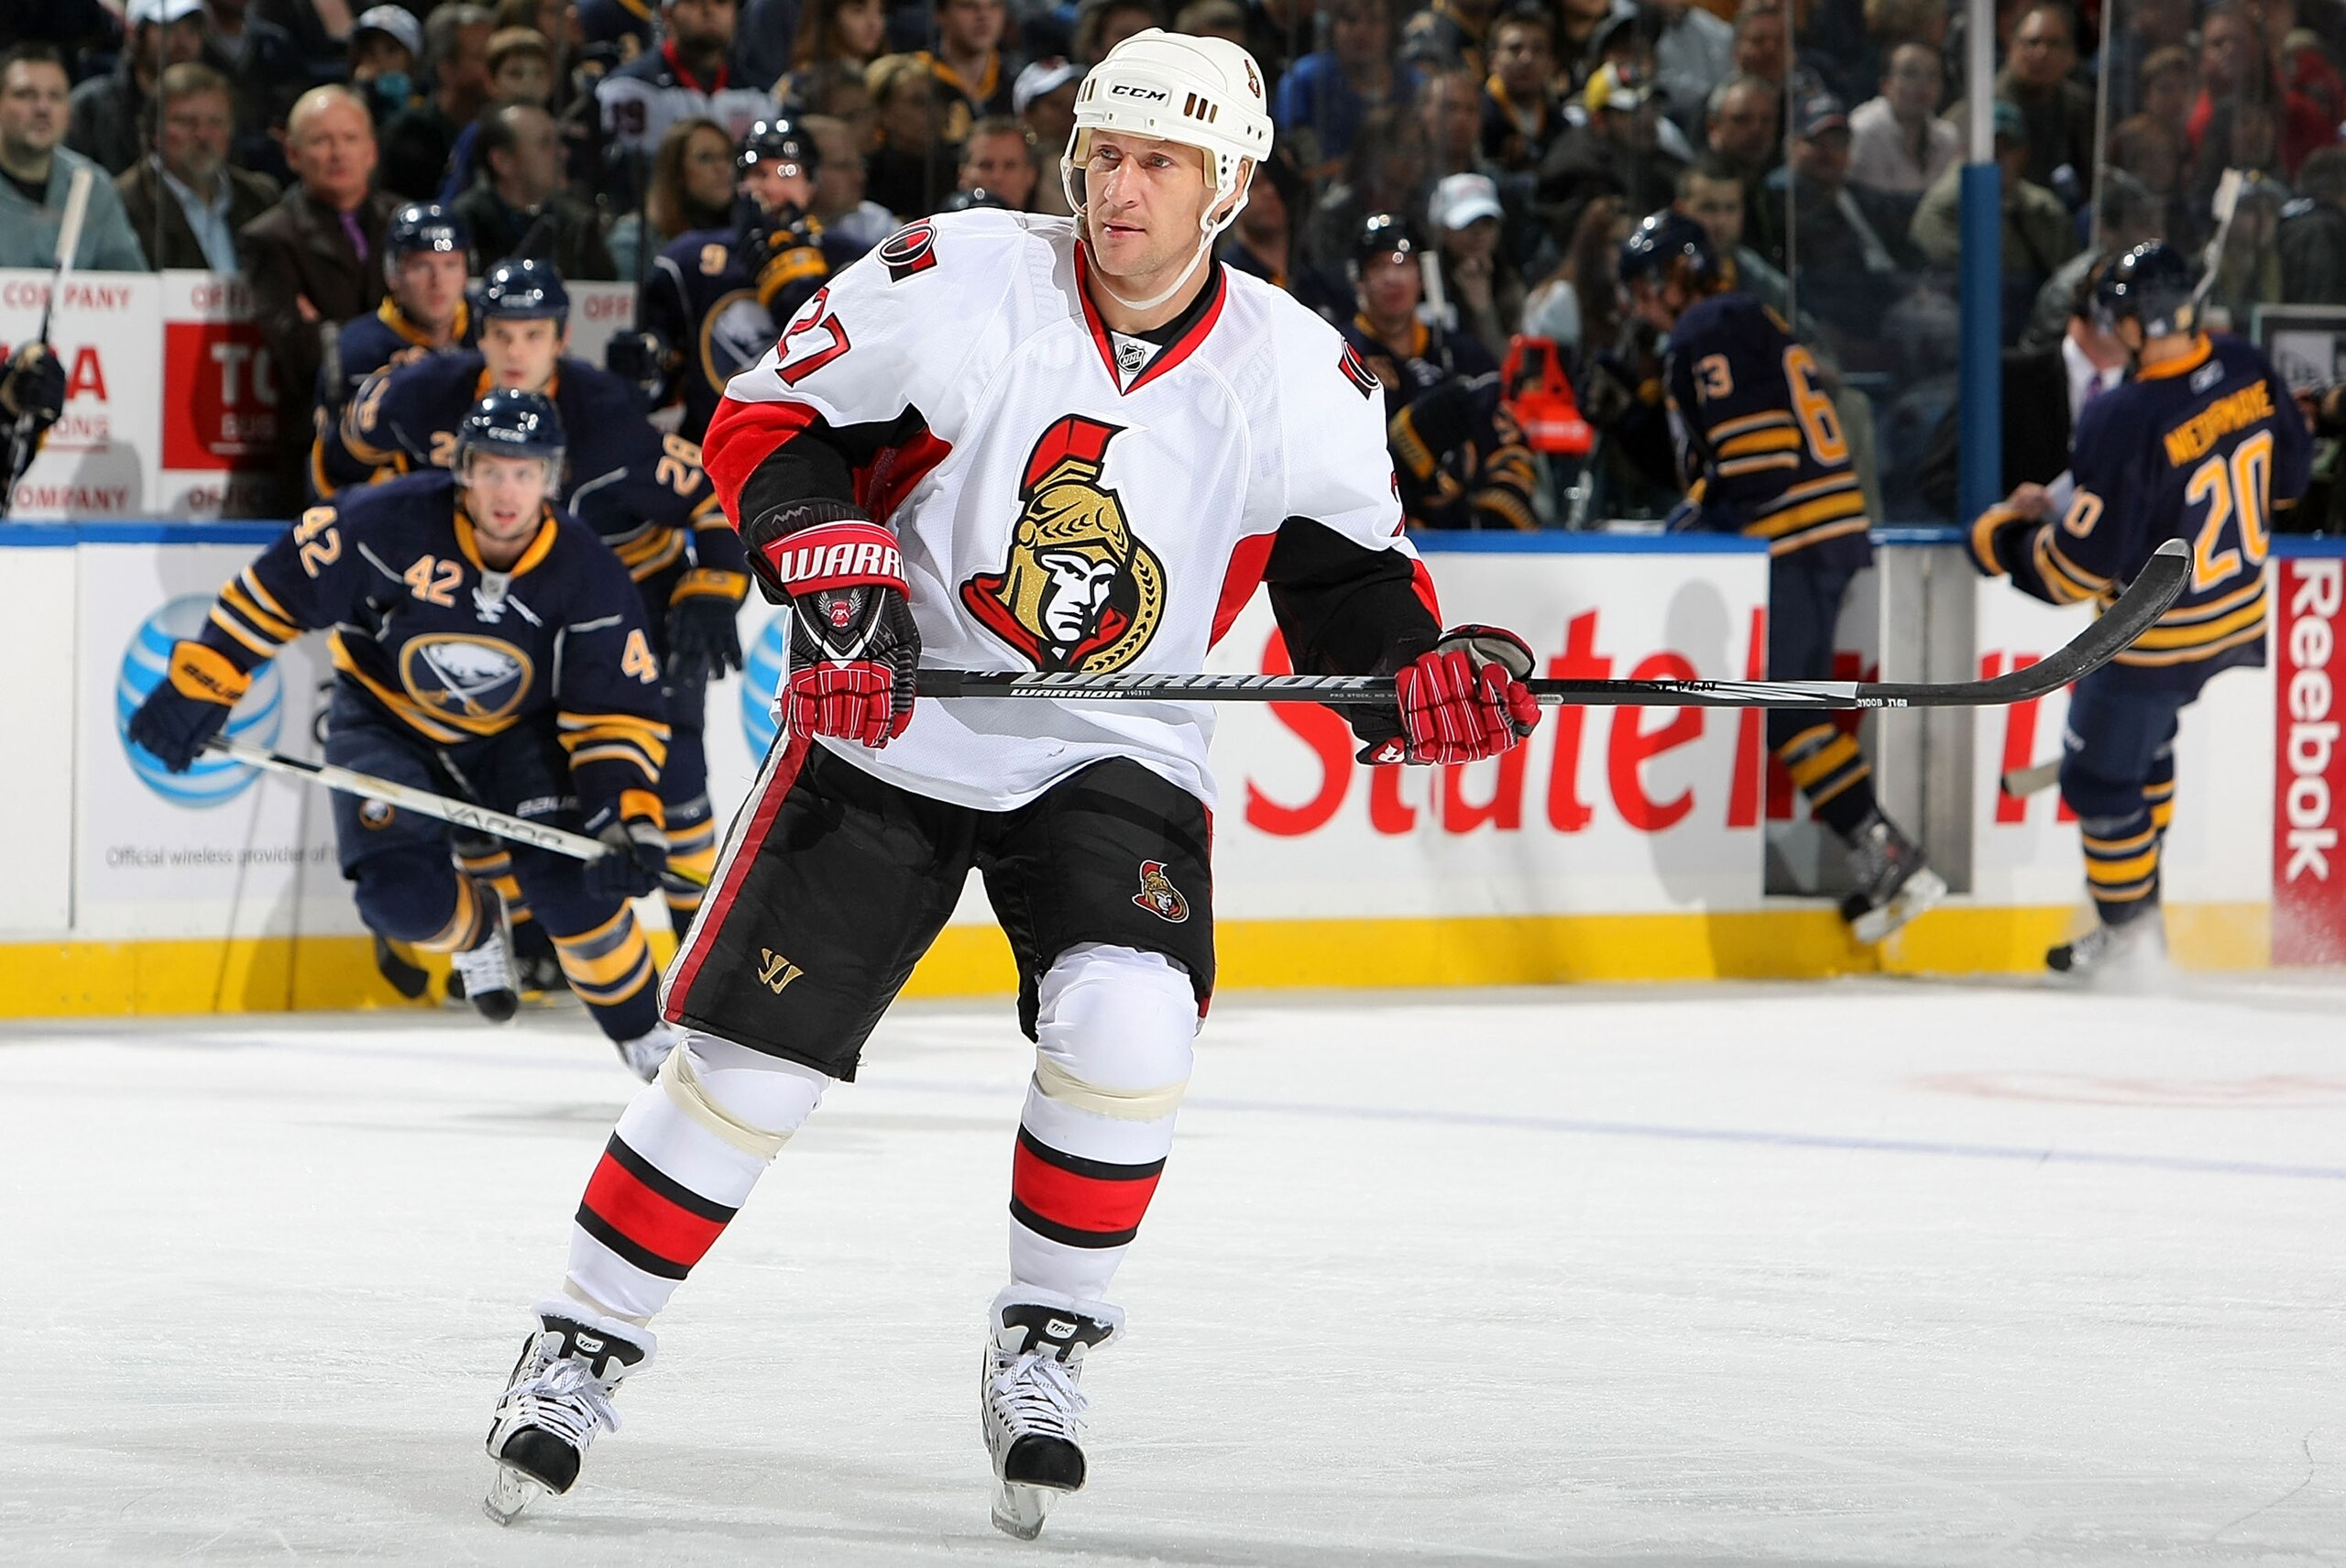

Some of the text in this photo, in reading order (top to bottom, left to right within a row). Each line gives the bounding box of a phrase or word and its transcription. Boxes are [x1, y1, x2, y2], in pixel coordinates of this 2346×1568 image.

[1112, 85, 1167, 101] CCM
[699, 243, 729, 276] 9
[584, 294, 632, 321] OFF
[773, 285, 851, 389] 27
[52, 414, 109, 437] ONS
[430, 430, 457, 468] 2
[16, 484, 128, 510] OMPANY
[2062, 488, 2105, 539] 0
[2185, 427, 2275, 594] 20
[293, 506, 343, 579] 42
[403, 554, 464, 609] 42
[1009, 671, 1375, 691] WARRIOR
[1010, 688, 1124, 698] WARRIOR
[2286, 557, 2343, 883] Reebok
[170, 844, 231, 866] wireless
[241, 844, 305, 870] provider
